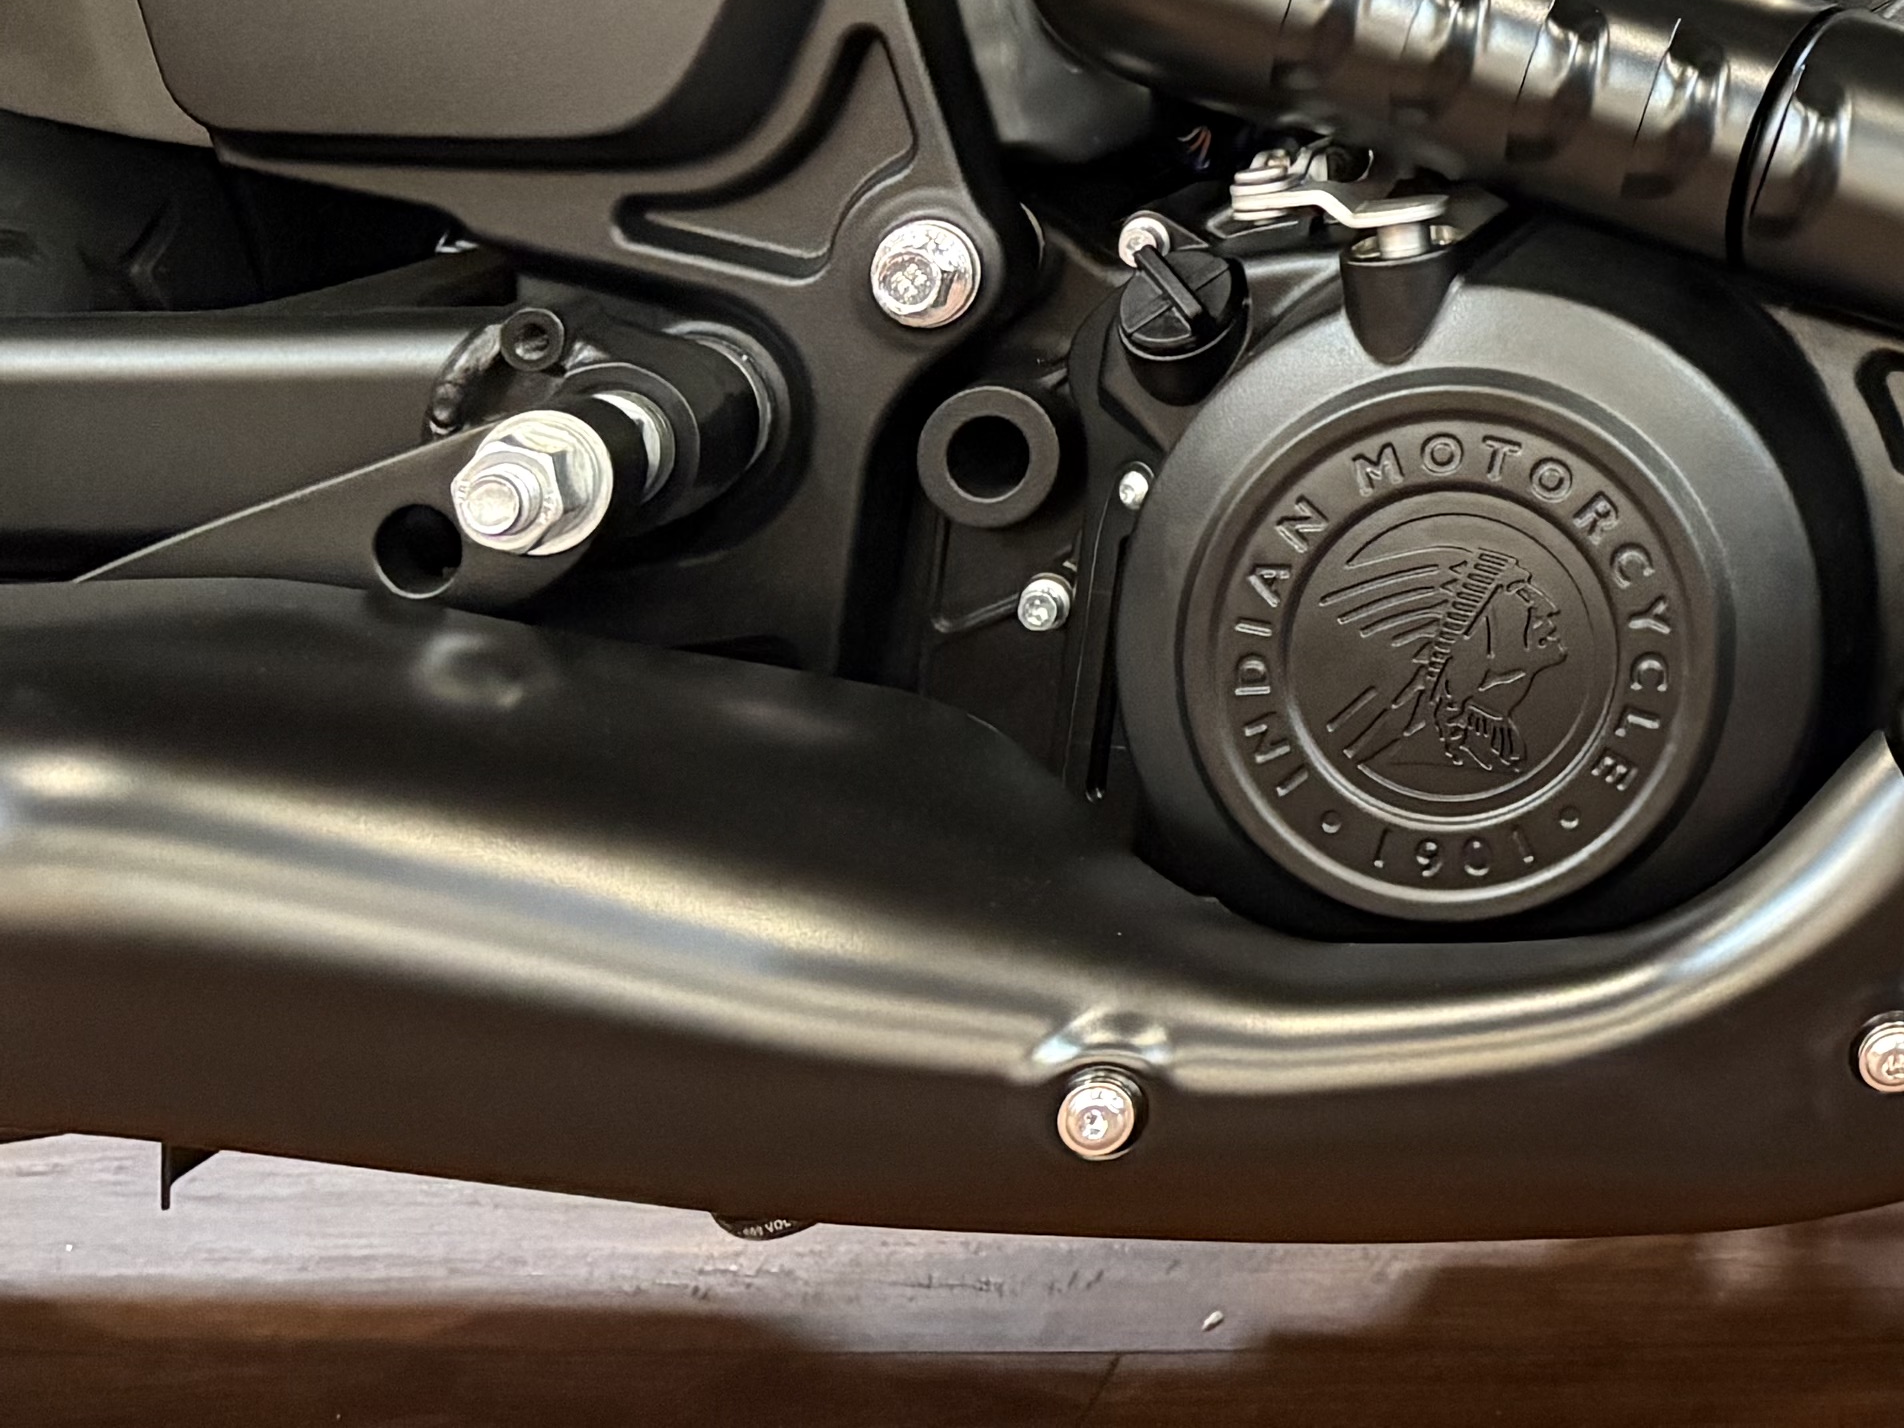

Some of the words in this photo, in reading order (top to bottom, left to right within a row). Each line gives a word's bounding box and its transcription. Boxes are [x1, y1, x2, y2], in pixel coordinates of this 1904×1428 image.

[1233, 498, 1330, 797] INDIAN
[1350, 432, 1673, 793] MOTORCYCLE
[1373, 826, 1537, 877] 1901
